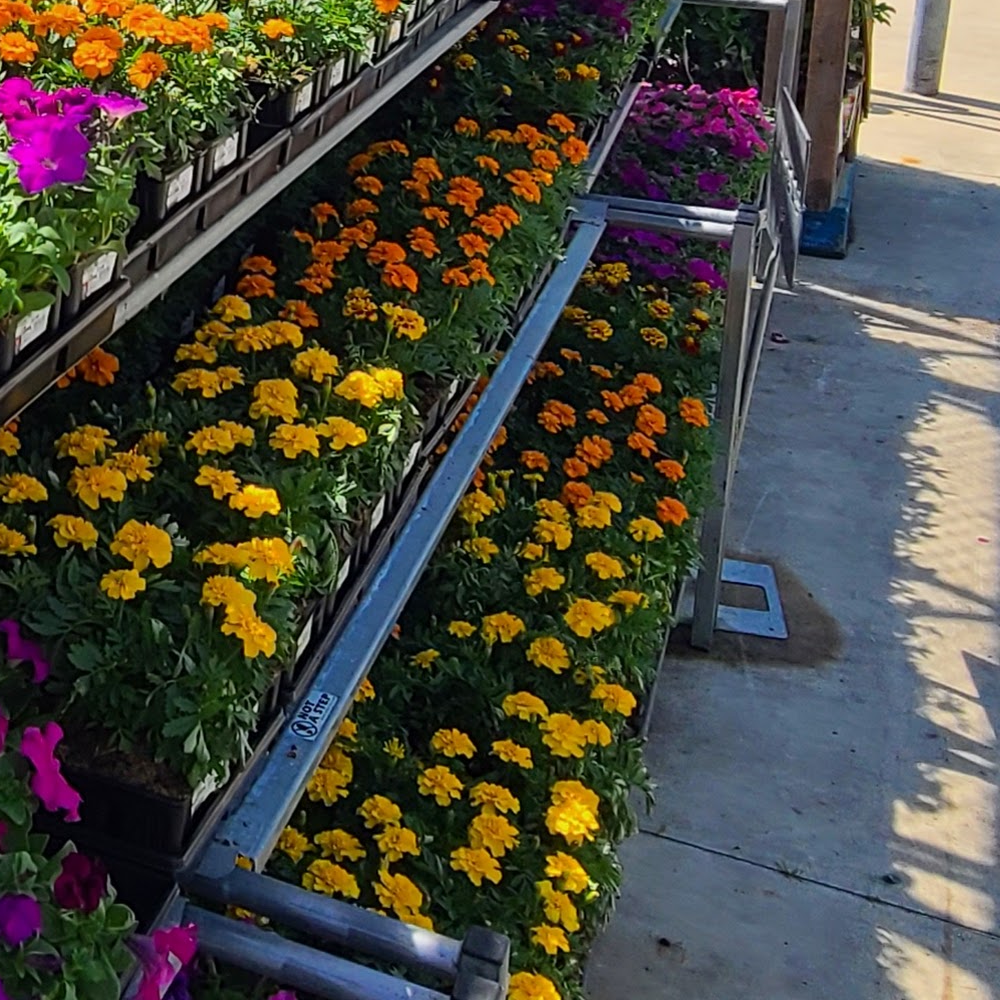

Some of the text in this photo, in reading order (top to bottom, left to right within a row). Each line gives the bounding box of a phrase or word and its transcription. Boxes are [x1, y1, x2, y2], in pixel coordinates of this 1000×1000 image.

[297, 699, 315, 720] NOT
[309, 693, 330, 724] A STEP
